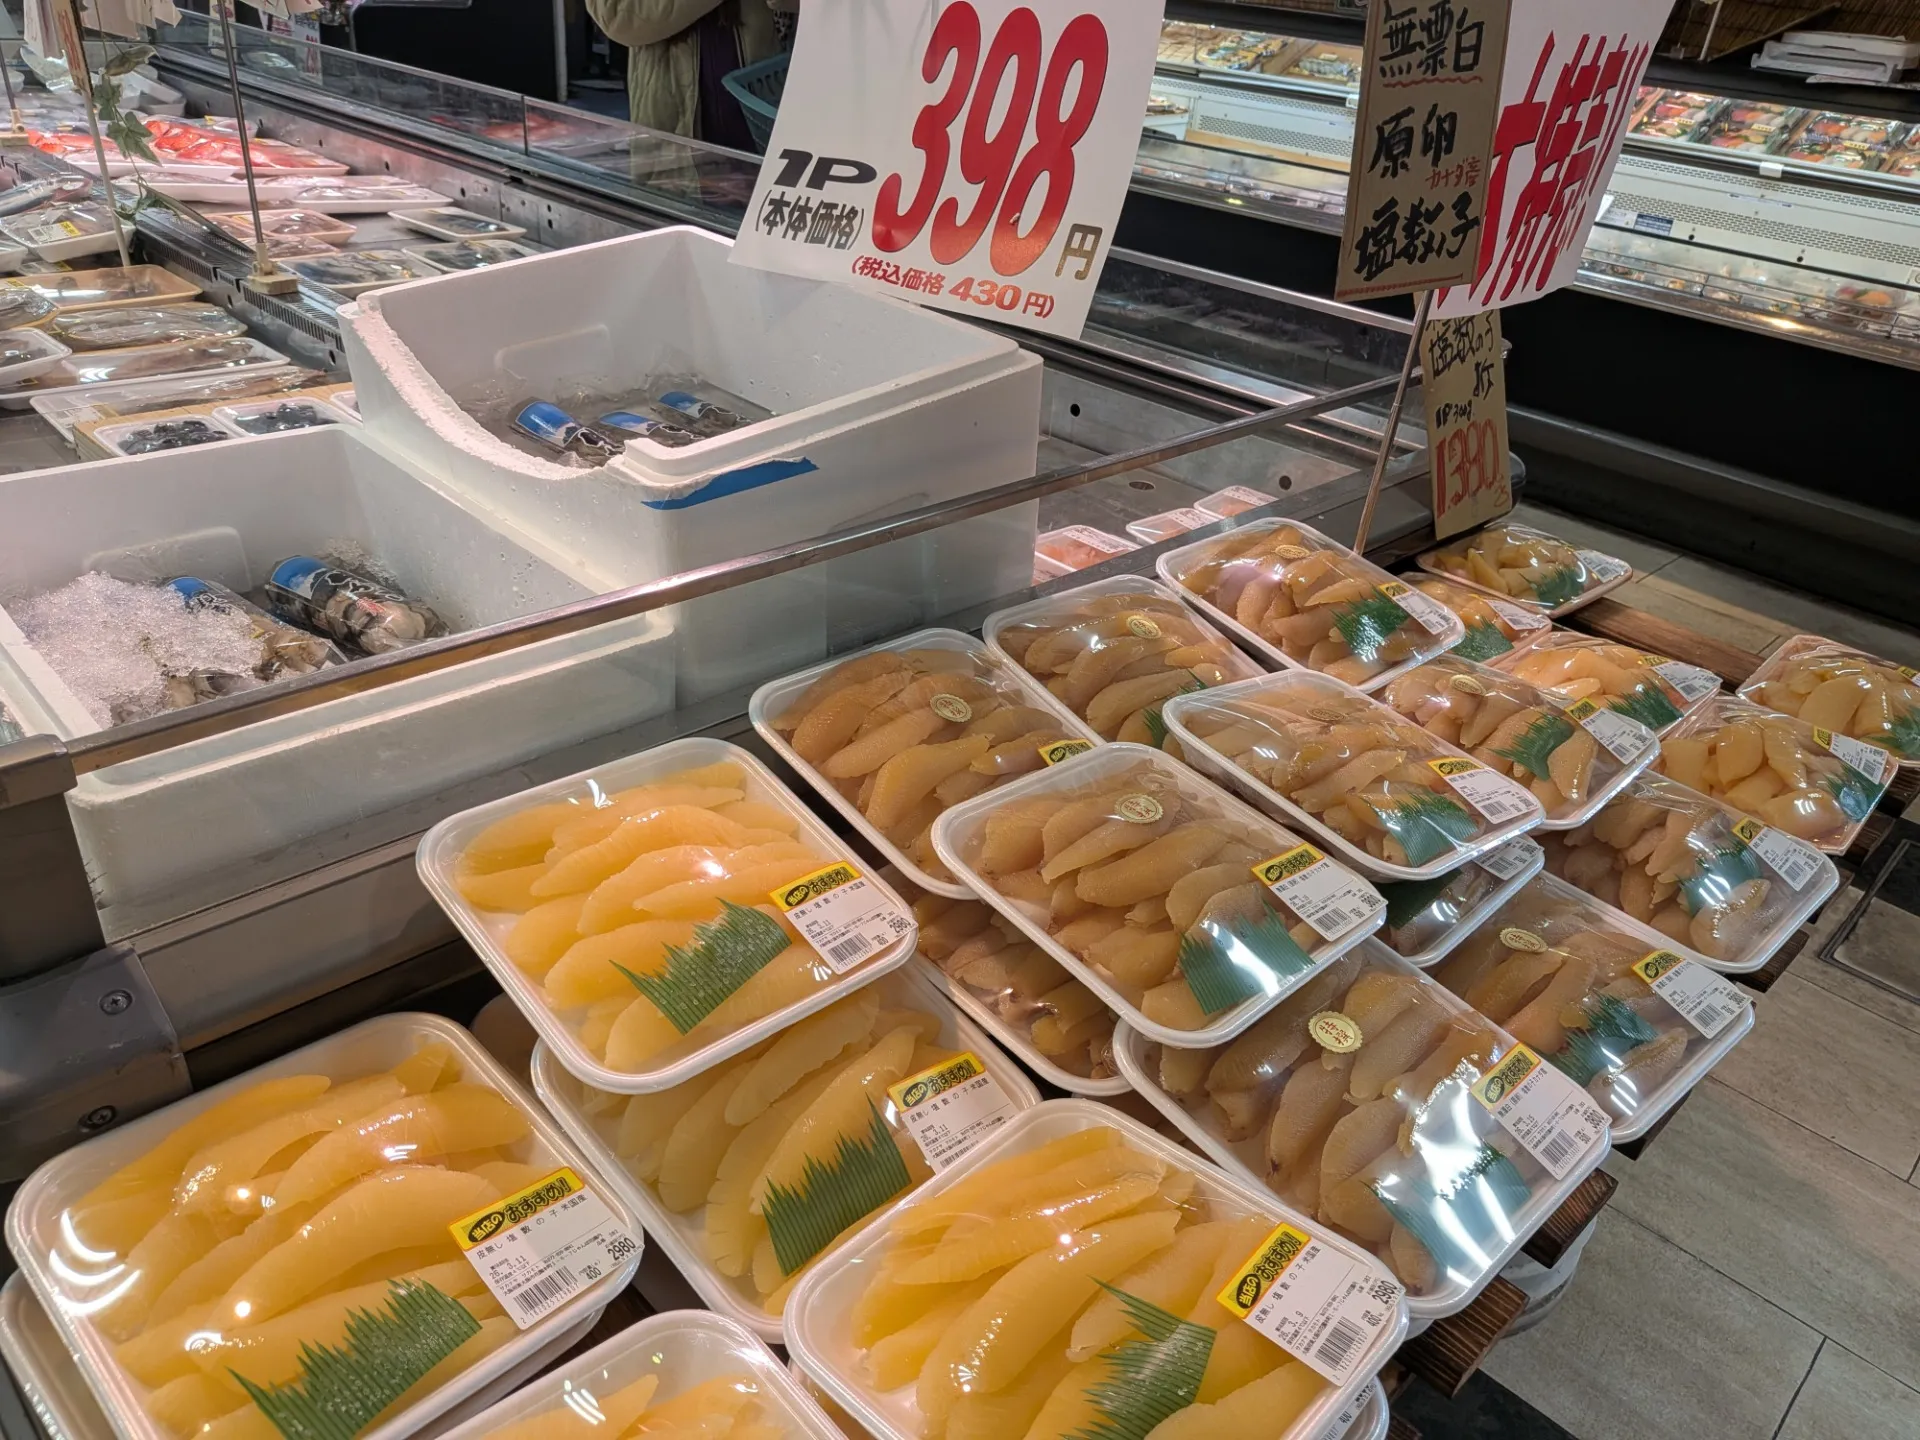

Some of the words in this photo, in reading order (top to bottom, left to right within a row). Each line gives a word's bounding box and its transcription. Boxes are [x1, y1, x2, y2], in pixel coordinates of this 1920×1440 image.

[1367, 103, 1457, 179] 原卵
[773, 148, 878, 191] 1P
[1318, 1020, 1354, 1046] 特撰
[470, 1212, 504, 1241] 当店の
[607, 1237, 636, 1261] 2980
[586, 1268, 600, 1280] 400
[1239, 1275, 1260, 1306] 当店の
[1372, 1280, 1397, 1305] 2980
[1366, 1314, 1380, 1326] 400
